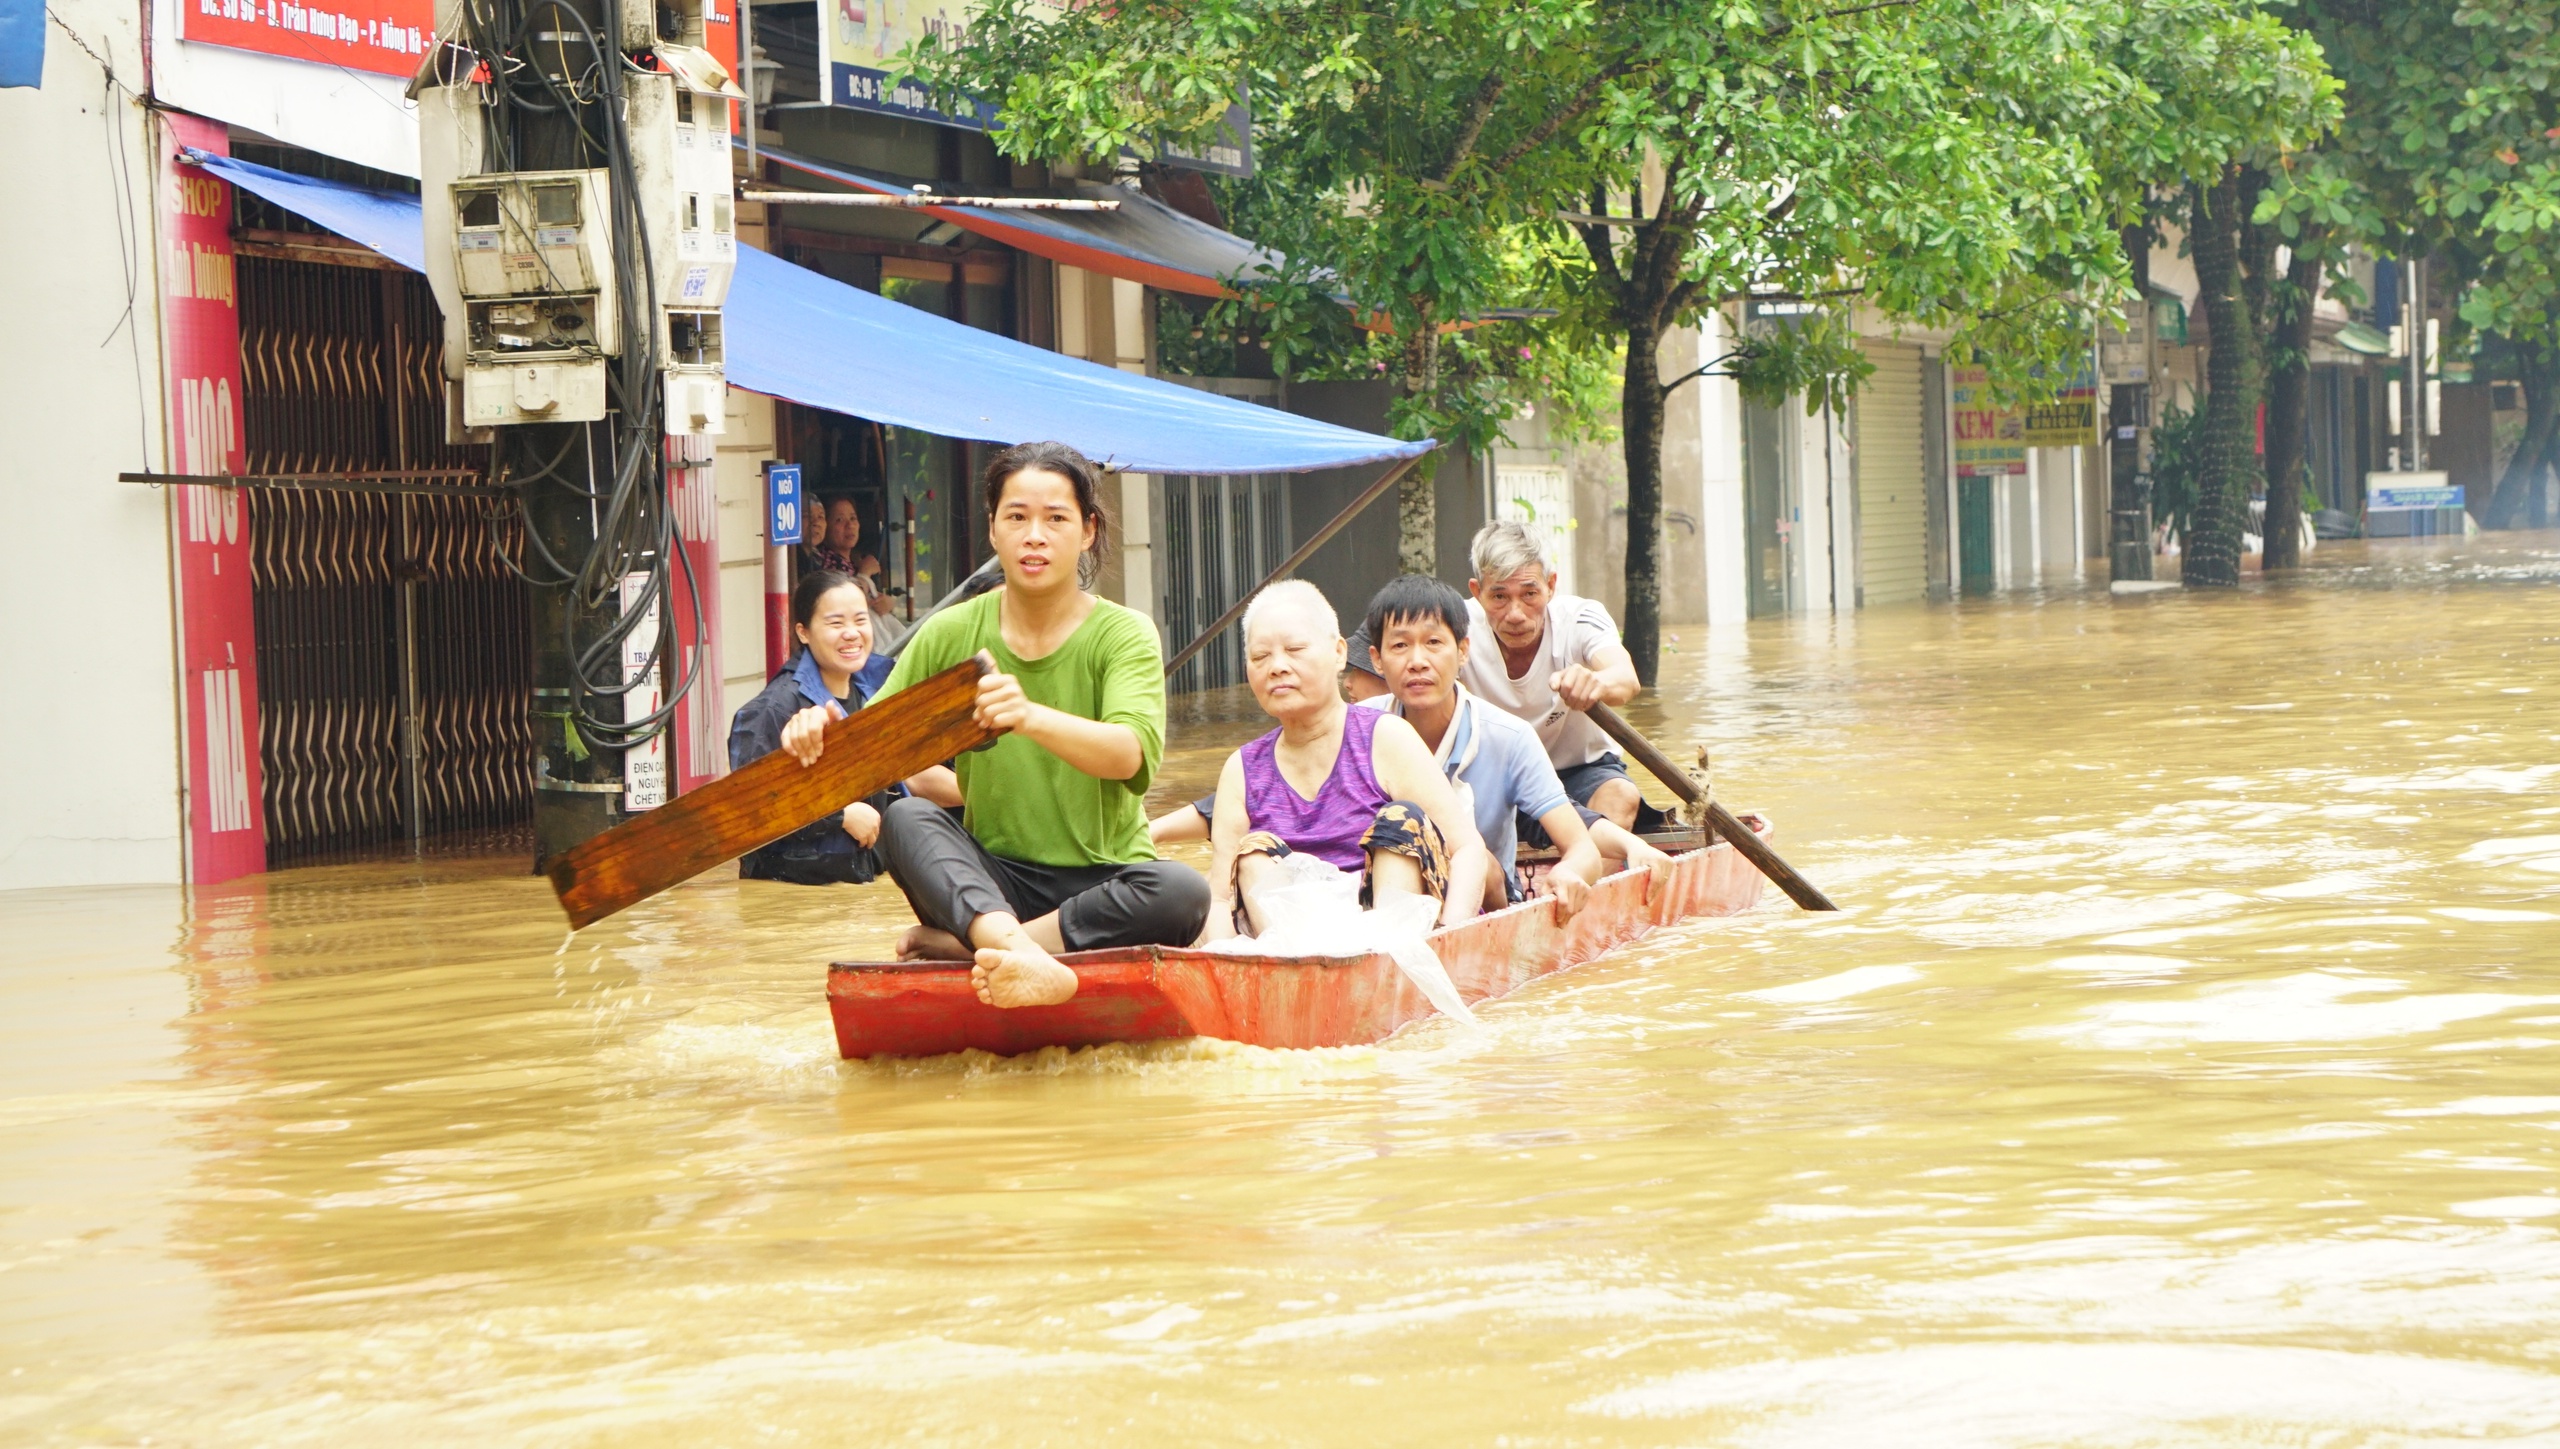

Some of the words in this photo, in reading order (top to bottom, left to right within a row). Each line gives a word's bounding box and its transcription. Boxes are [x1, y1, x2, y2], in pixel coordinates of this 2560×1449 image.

[310, 7, 336, 40] Hưng
[338, 13, 359, 46] Đạo
[381, 17, 406, 53] Hồng
[408, 26, 422, 54] Hà
[170, 174, 222, 218] SHOP
[1954, 411, 1995, 439] KEM
[2031, 417, 2079, 429] UNION
[778, 475, 793, 495] NGÕ
[777, 502, 796, 531] 90
[634, 760, 654, 775] ĐIỆN
[638, 778, 659, 789] NGUY
